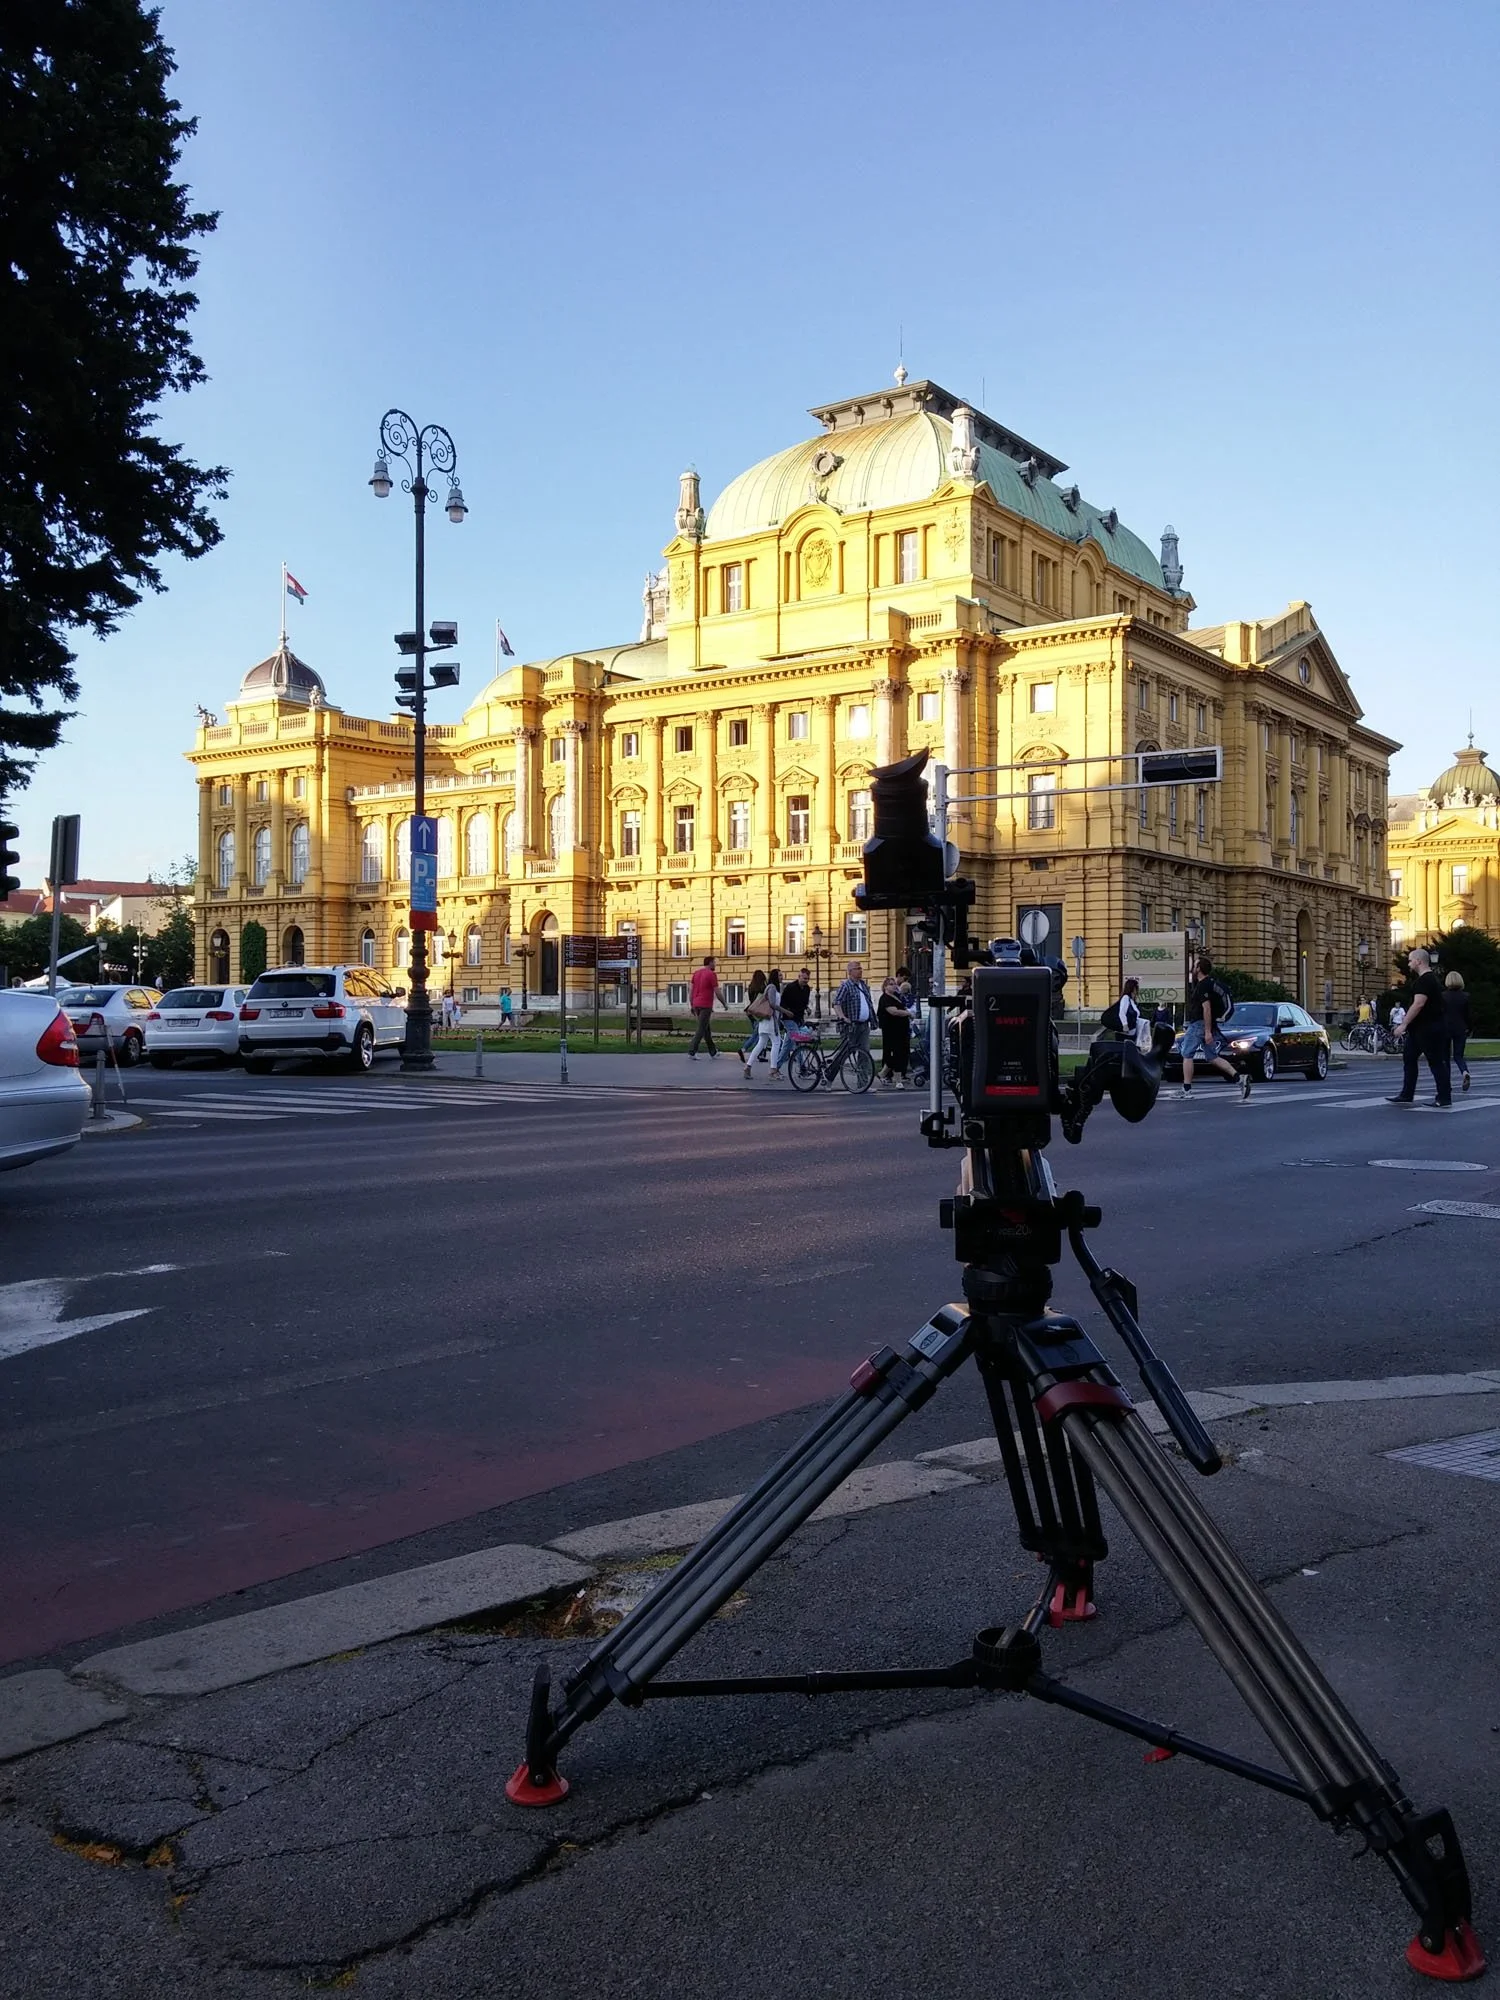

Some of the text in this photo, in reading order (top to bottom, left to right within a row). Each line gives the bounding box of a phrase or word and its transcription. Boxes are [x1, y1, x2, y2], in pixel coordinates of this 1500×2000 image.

[414, 858, 428, 884] P
[989, 996, 1000, 1012] 2
[995, 1015, 1027, 1025] SWIT
